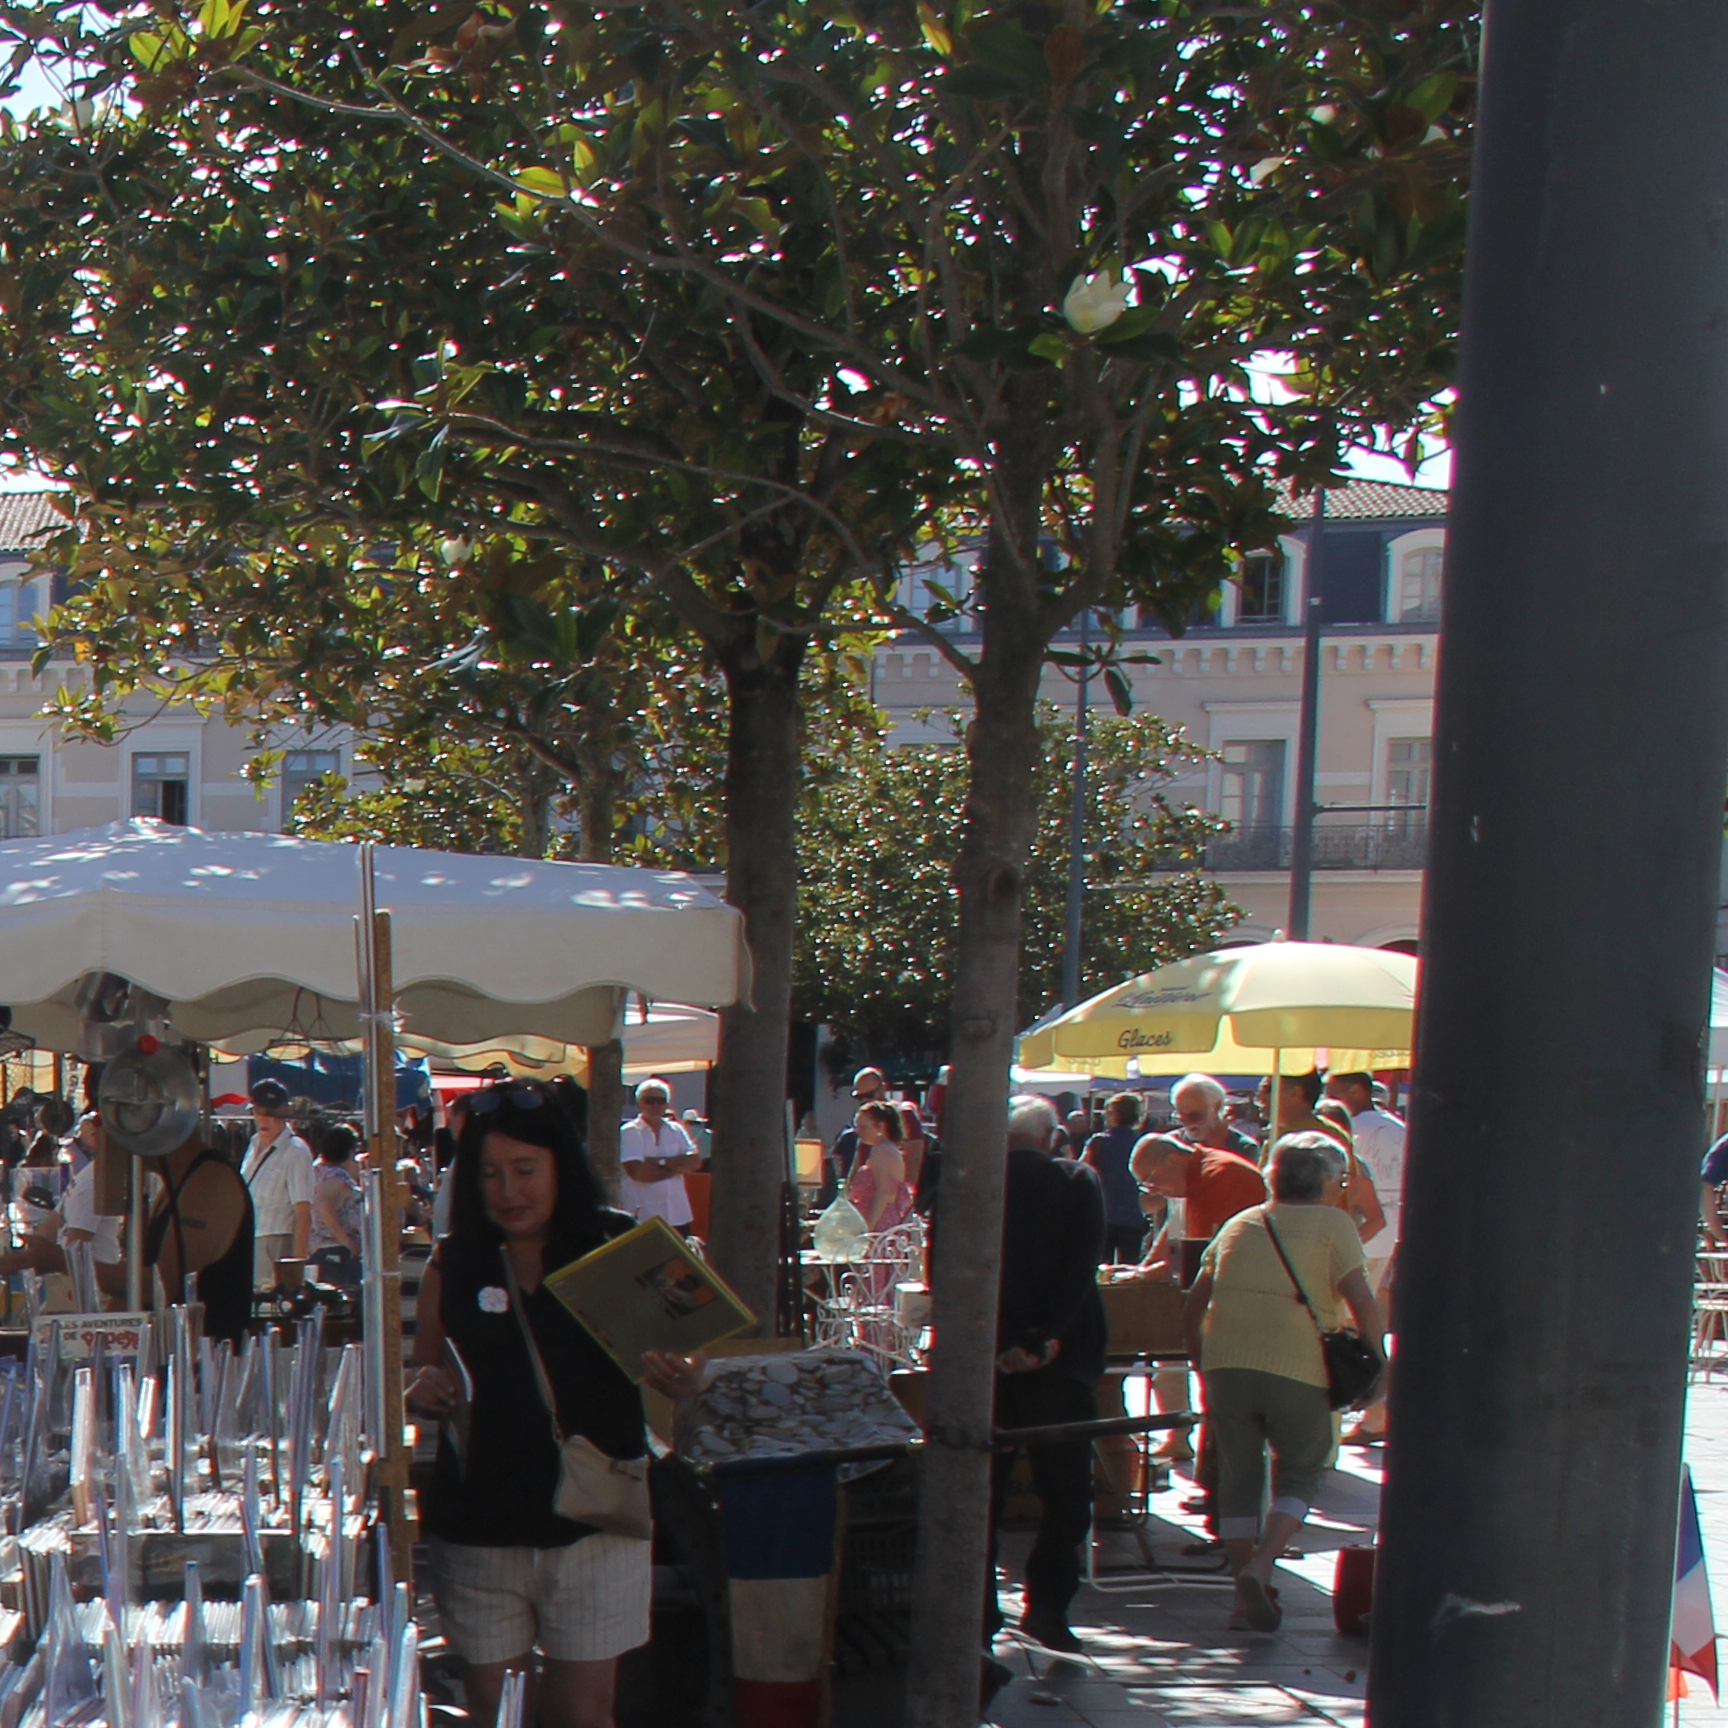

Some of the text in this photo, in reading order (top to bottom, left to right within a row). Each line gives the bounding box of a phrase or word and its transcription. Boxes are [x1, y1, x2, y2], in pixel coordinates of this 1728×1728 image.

[1117, 1028, 1174, 1048] Glaces
[80, 1317, 142, 1328] AVENTURES
[63, 1332, 78, 1341] DE
